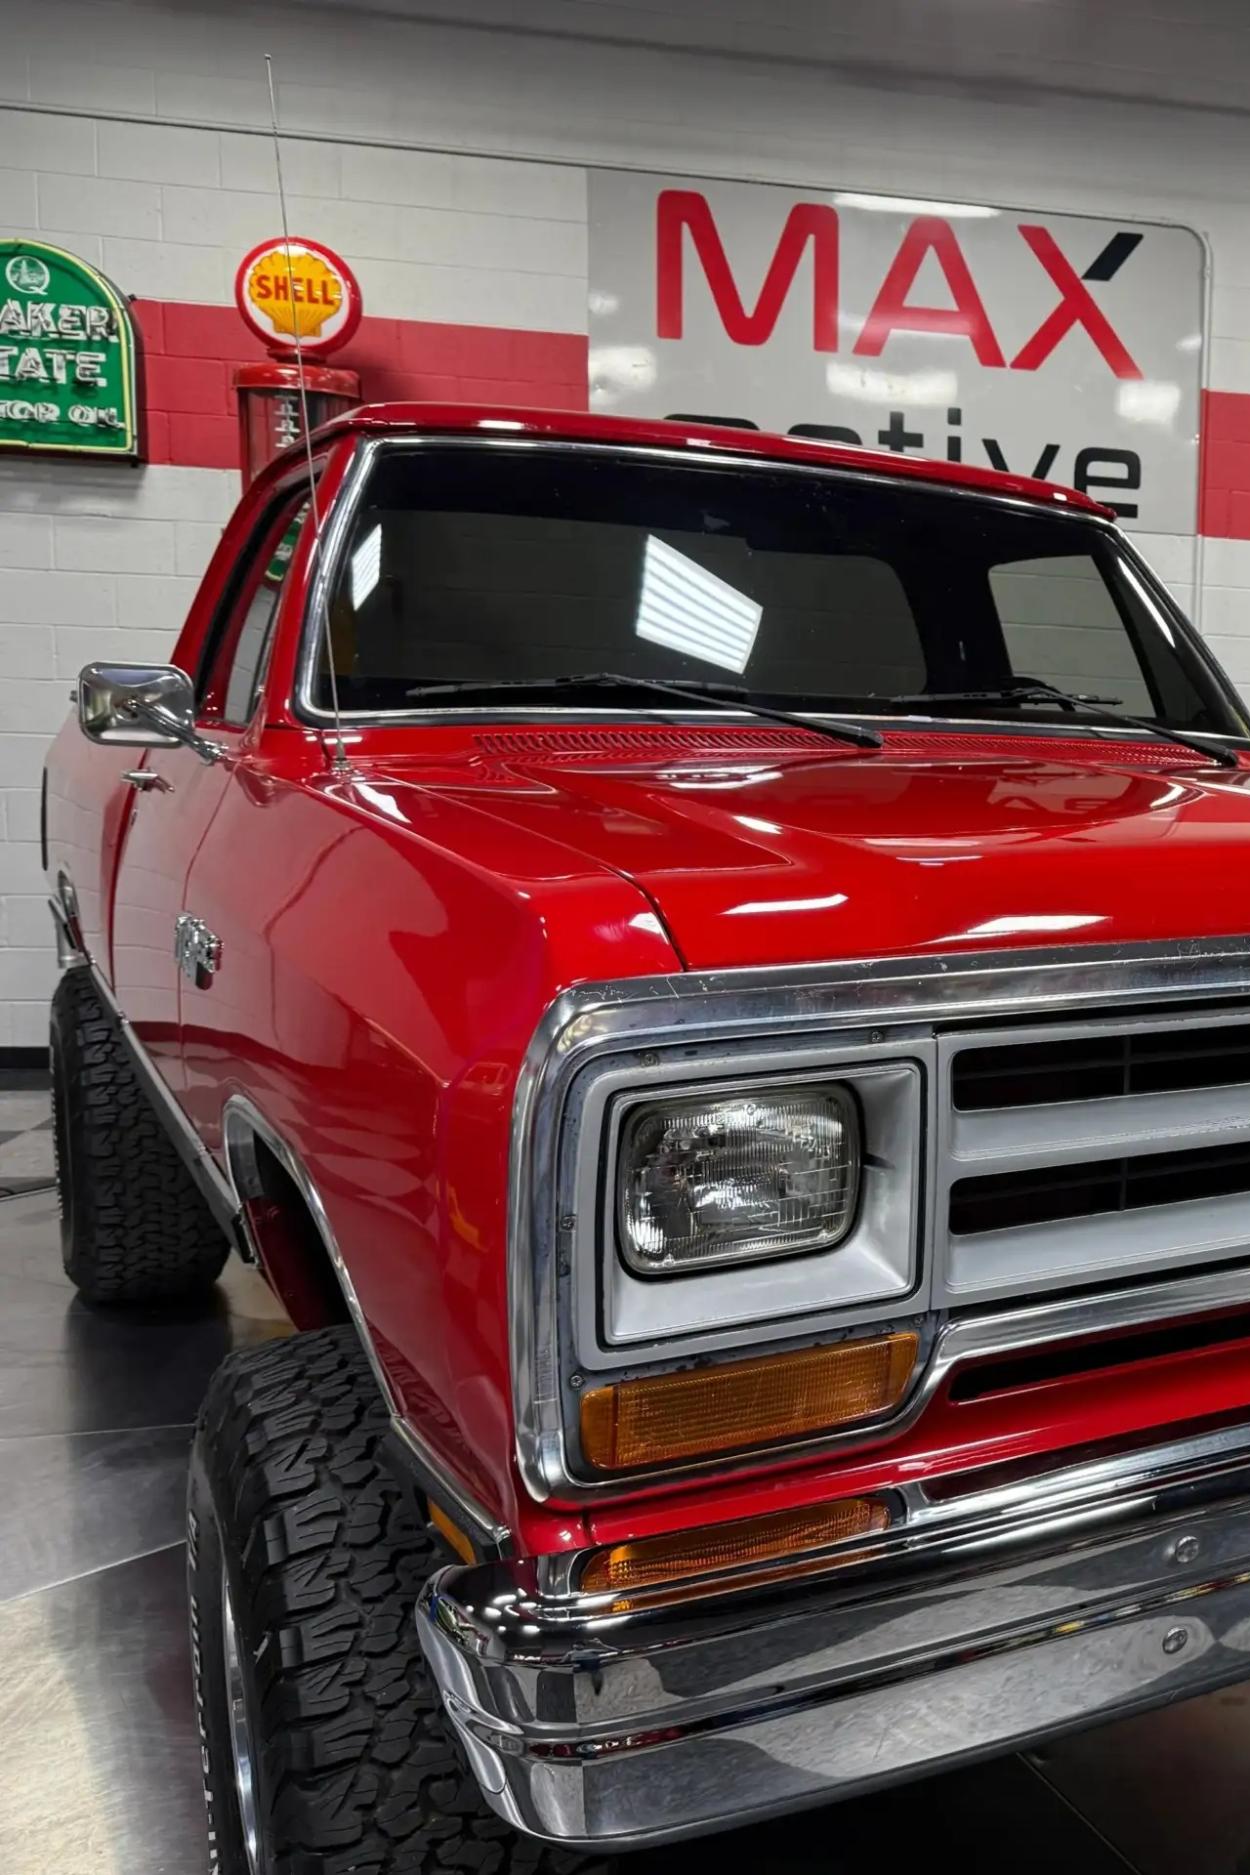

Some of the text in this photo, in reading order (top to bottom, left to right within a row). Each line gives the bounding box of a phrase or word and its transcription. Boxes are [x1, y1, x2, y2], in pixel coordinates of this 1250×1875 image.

[255, 274, 336, 306] SHELL
[656, 189, 1144, 380] MAX
[663, 407, 1141, 518] tive
